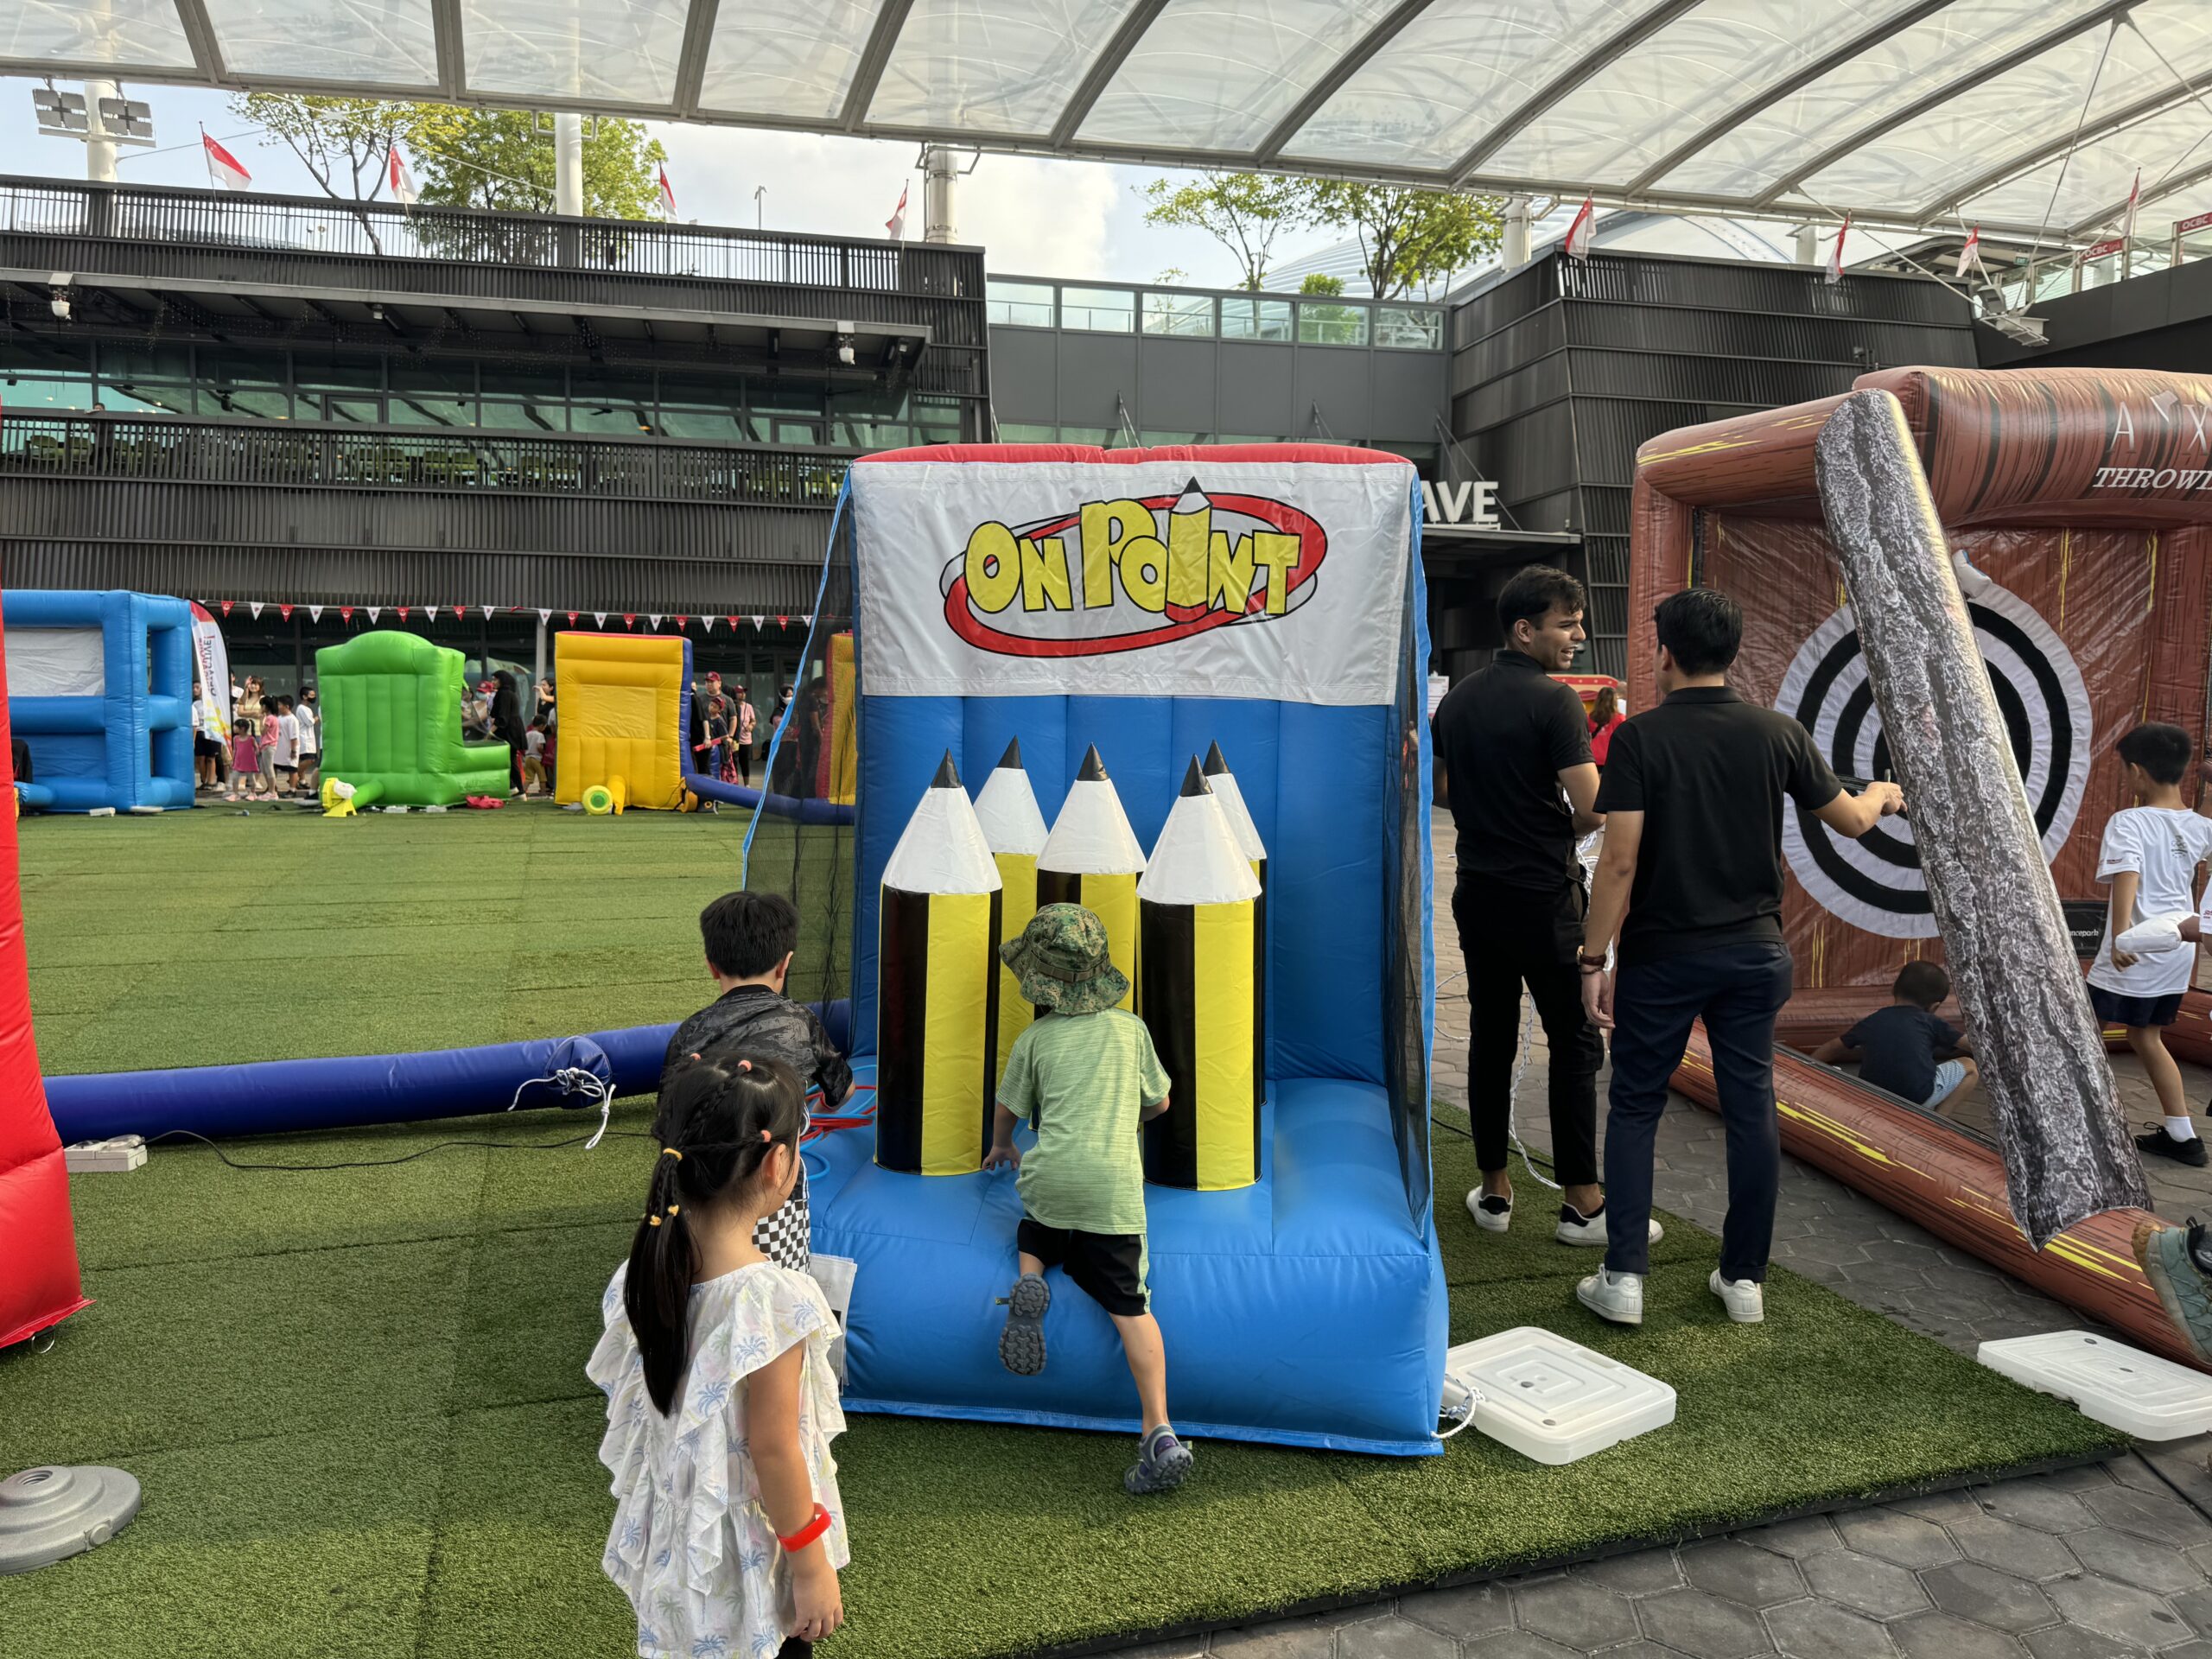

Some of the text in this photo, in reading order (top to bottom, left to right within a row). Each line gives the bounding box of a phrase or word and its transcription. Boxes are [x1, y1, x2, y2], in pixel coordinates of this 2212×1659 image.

[2182, 215, 2209, 230] OCBC
[2084, 245, 2108, 257] OCBC
[963, 520, 1073, 613] ON
[2070, 929, 2099, 938] ncepark
